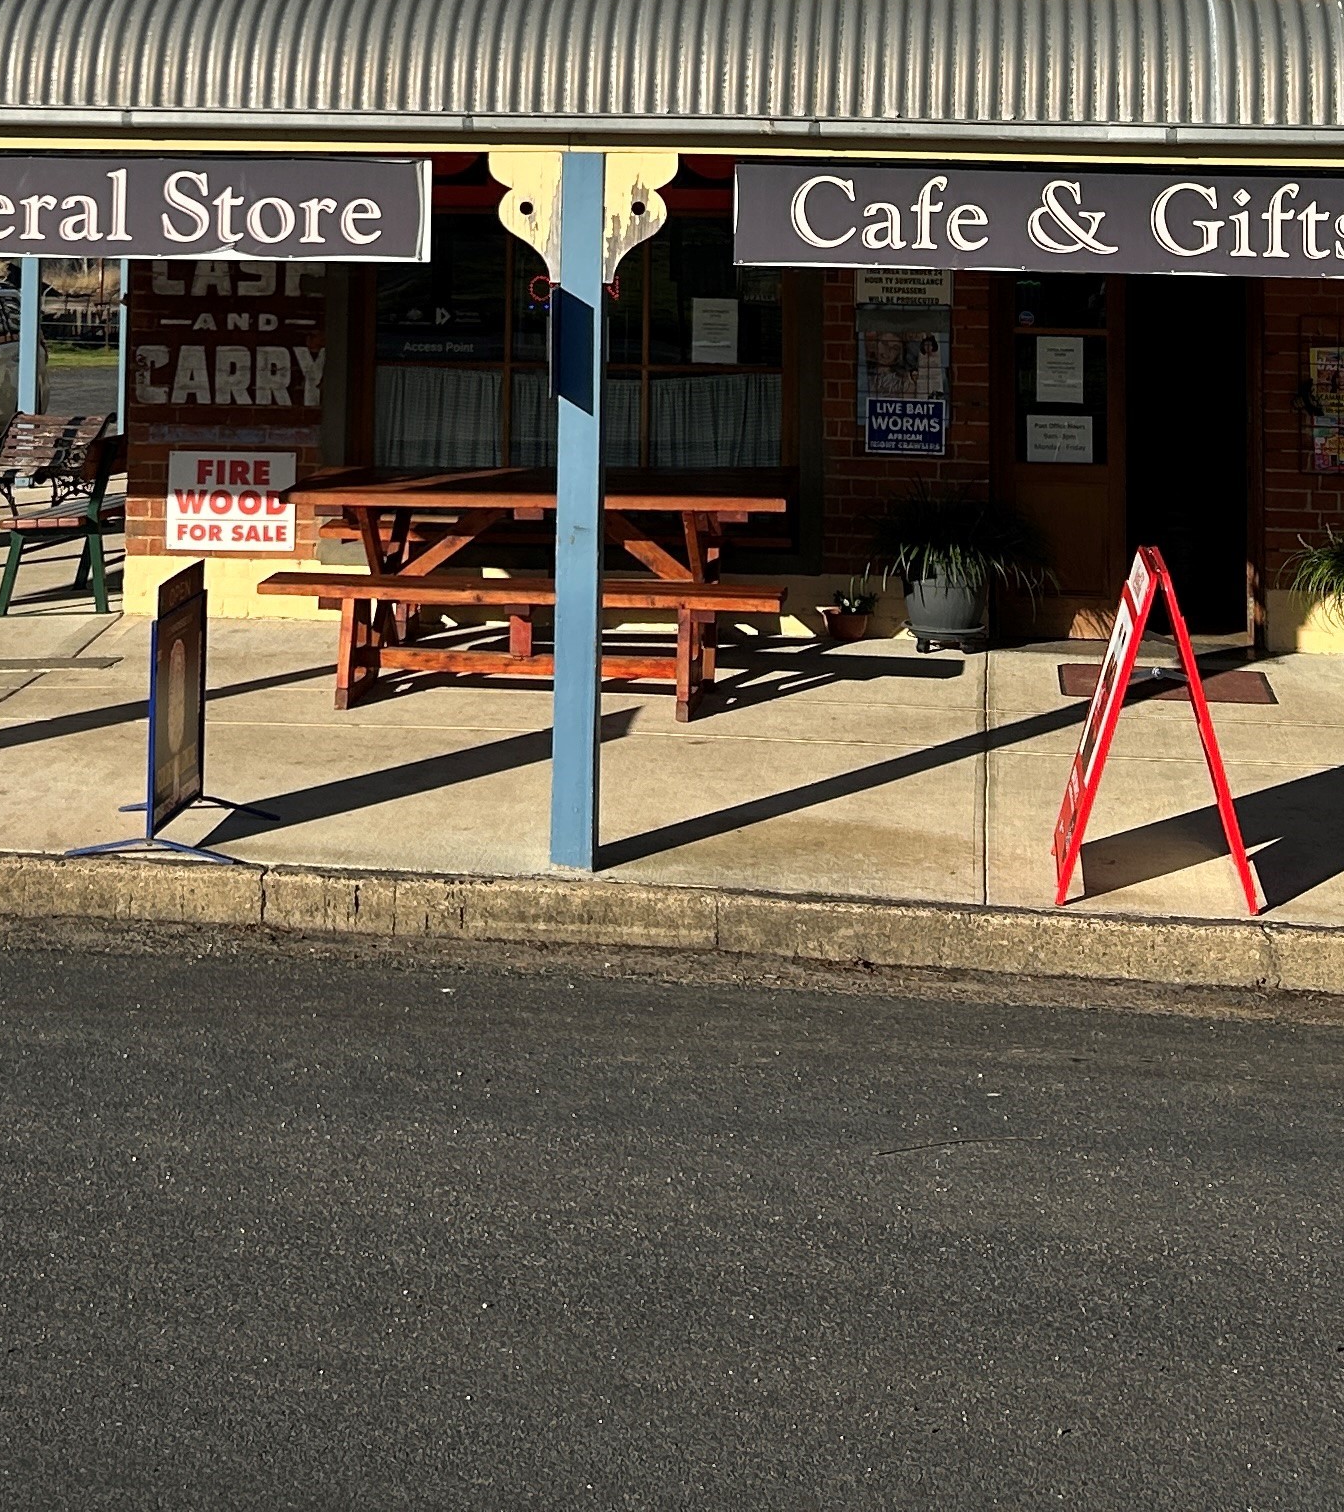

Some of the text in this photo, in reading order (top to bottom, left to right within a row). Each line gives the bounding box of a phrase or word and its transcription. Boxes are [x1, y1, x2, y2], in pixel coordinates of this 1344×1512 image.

[161, 170, 384, 245] Store
[790, 175, 991, 252] Cafe
[1027, 180, 1120, 255] &
[864, 276, 884, 285] HOUR
[881, 286, 927, 295] TRESPASSERS
[868, 295, 940, 305] WILL BE PROSECUTED
[192, 312, 279, 332] AND
[403, 341, 474, 353] Access Point
[134, 344, 327, 407] CARRY
[876, 402, 935, 416] LIVE BAIT
[871, 415, 941, 433] WORMS
[887, 432, 923, 442] AFRICAN
[197, 459, 271, 486] FIRE
[174, 488, 287, 516] WOOD
[177, 524, 288, 543] FOR SALE
